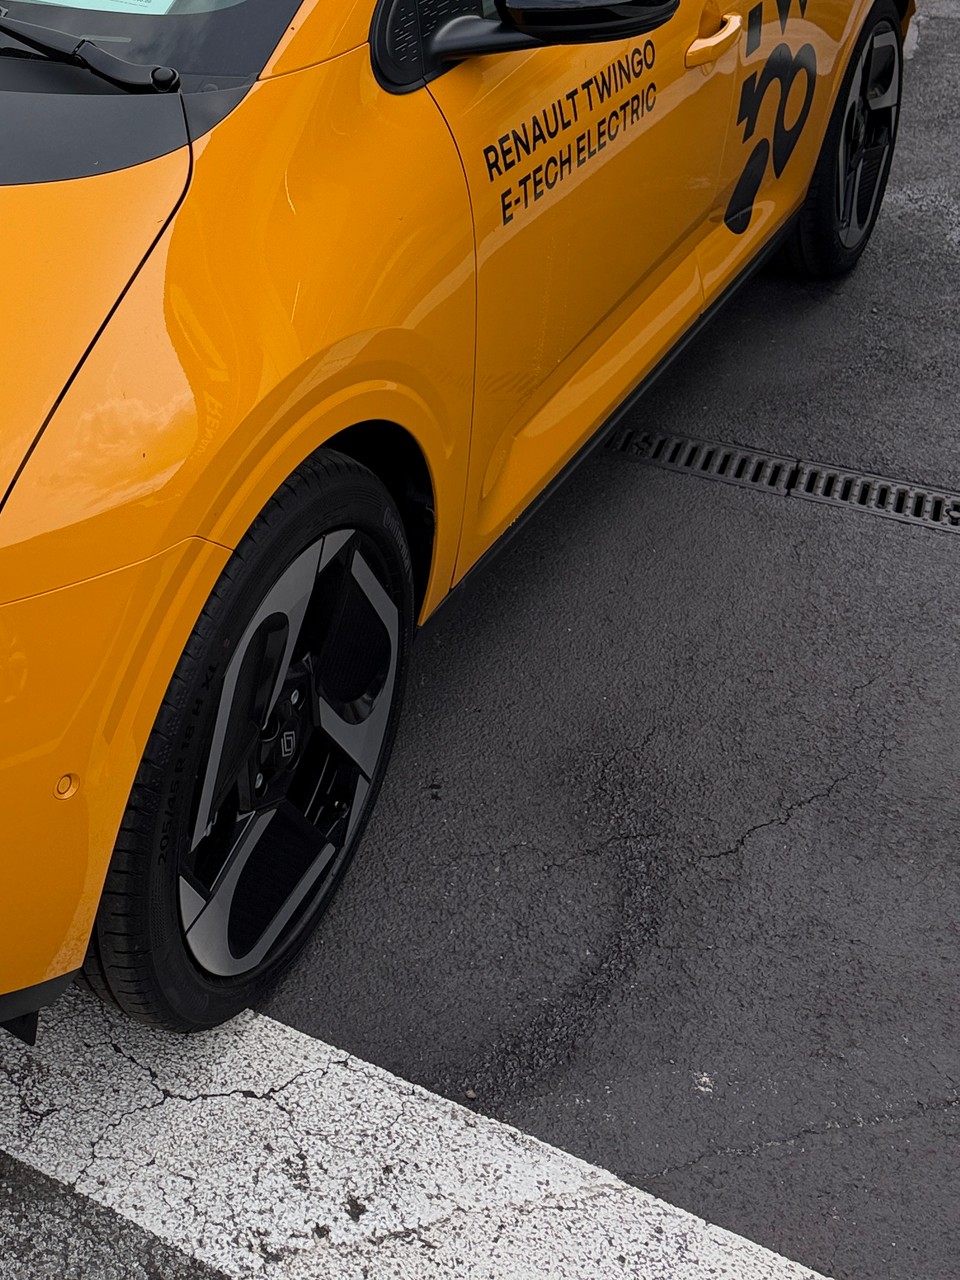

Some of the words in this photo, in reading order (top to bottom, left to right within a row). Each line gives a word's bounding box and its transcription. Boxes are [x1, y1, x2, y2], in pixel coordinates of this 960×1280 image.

[482, 87, 579, 183] RENAULT
[581, 39, 656, 112] TWINGO
[500, 143, 572, 226] E-TECH
[576, 82, 657, 168] ELECTRIC
[157, 779, 180, 868] 205/45
[174, 758, 186, 774] R
[181, 725, 196, 751] 18
[192, 698, 203, 716] H
[201, 661, 220, 691] XL
